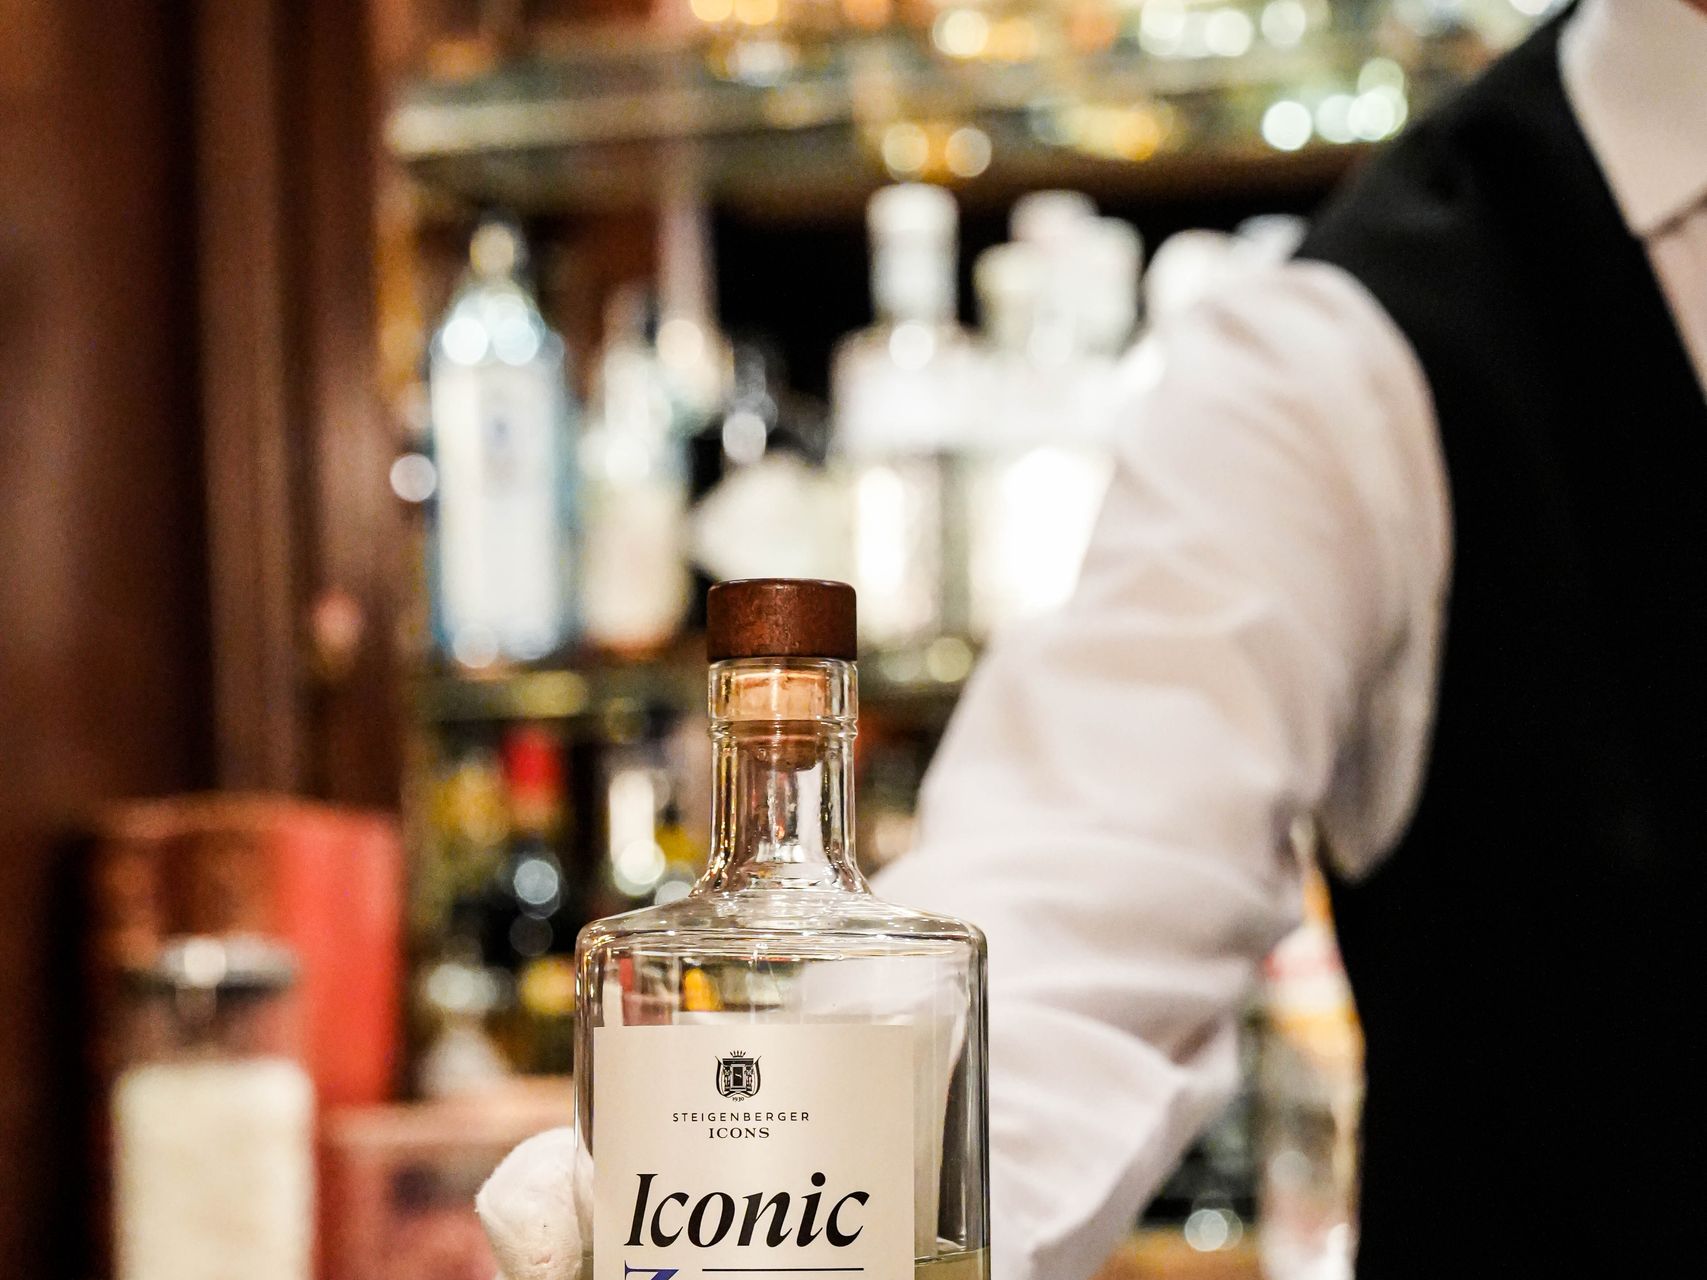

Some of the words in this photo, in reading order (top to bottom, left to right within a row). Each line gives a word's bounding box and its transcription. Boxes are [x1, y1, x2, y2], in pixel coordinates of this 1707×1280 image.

[672, 1111, 810, 1123] STEIGENBERGER
[708, 1126, 770, 1139] ICONS
[623, 1171, 871, 1249] Iconic
